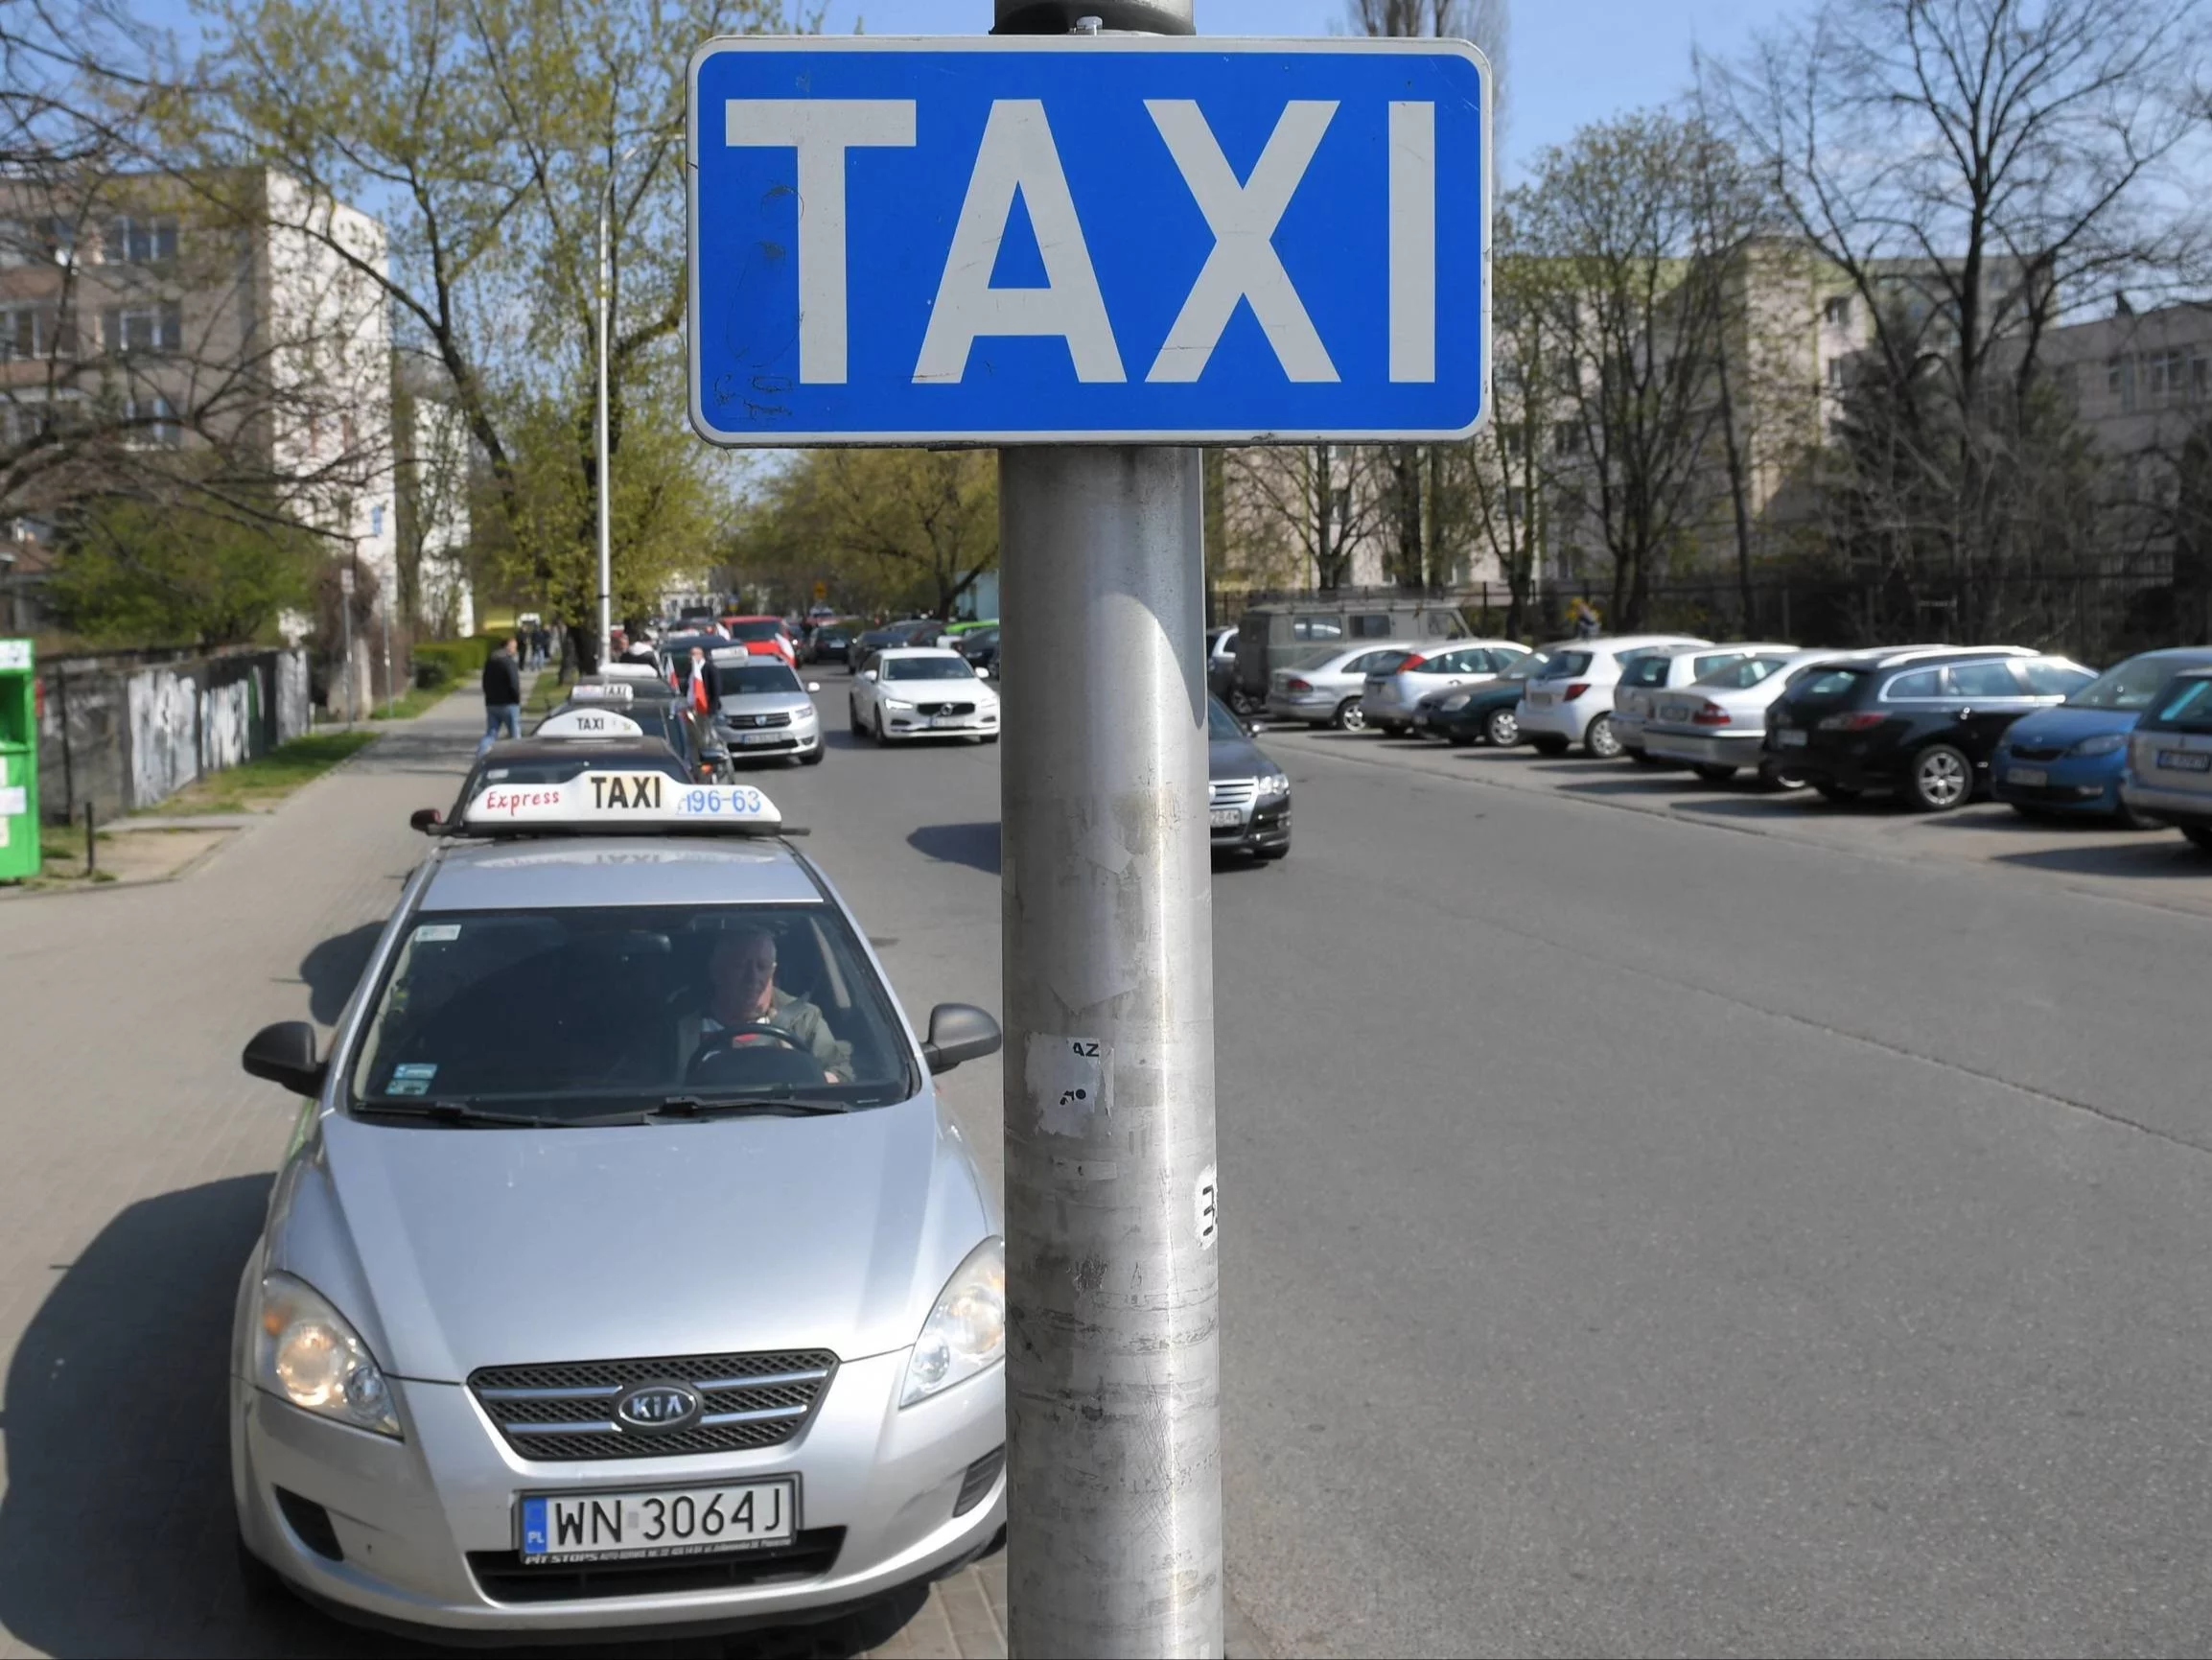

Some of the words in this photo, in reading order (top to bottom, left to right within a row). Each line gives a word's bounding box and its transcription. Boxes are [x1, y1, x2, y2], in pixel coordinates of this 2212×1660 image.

[725, 99, 1435, 384] TAXI
[577, 717, 604, 731] TAXI
[486, 789, 560, 816] Express
[591, 776, 662, 808] TAXI
[632, 1395, 683, 1419] KIA
[555, 1498, 622, 1547] WN
[641, 1487, 781, 1541] 3064J
[527, 1531, 546, 1544] PL
